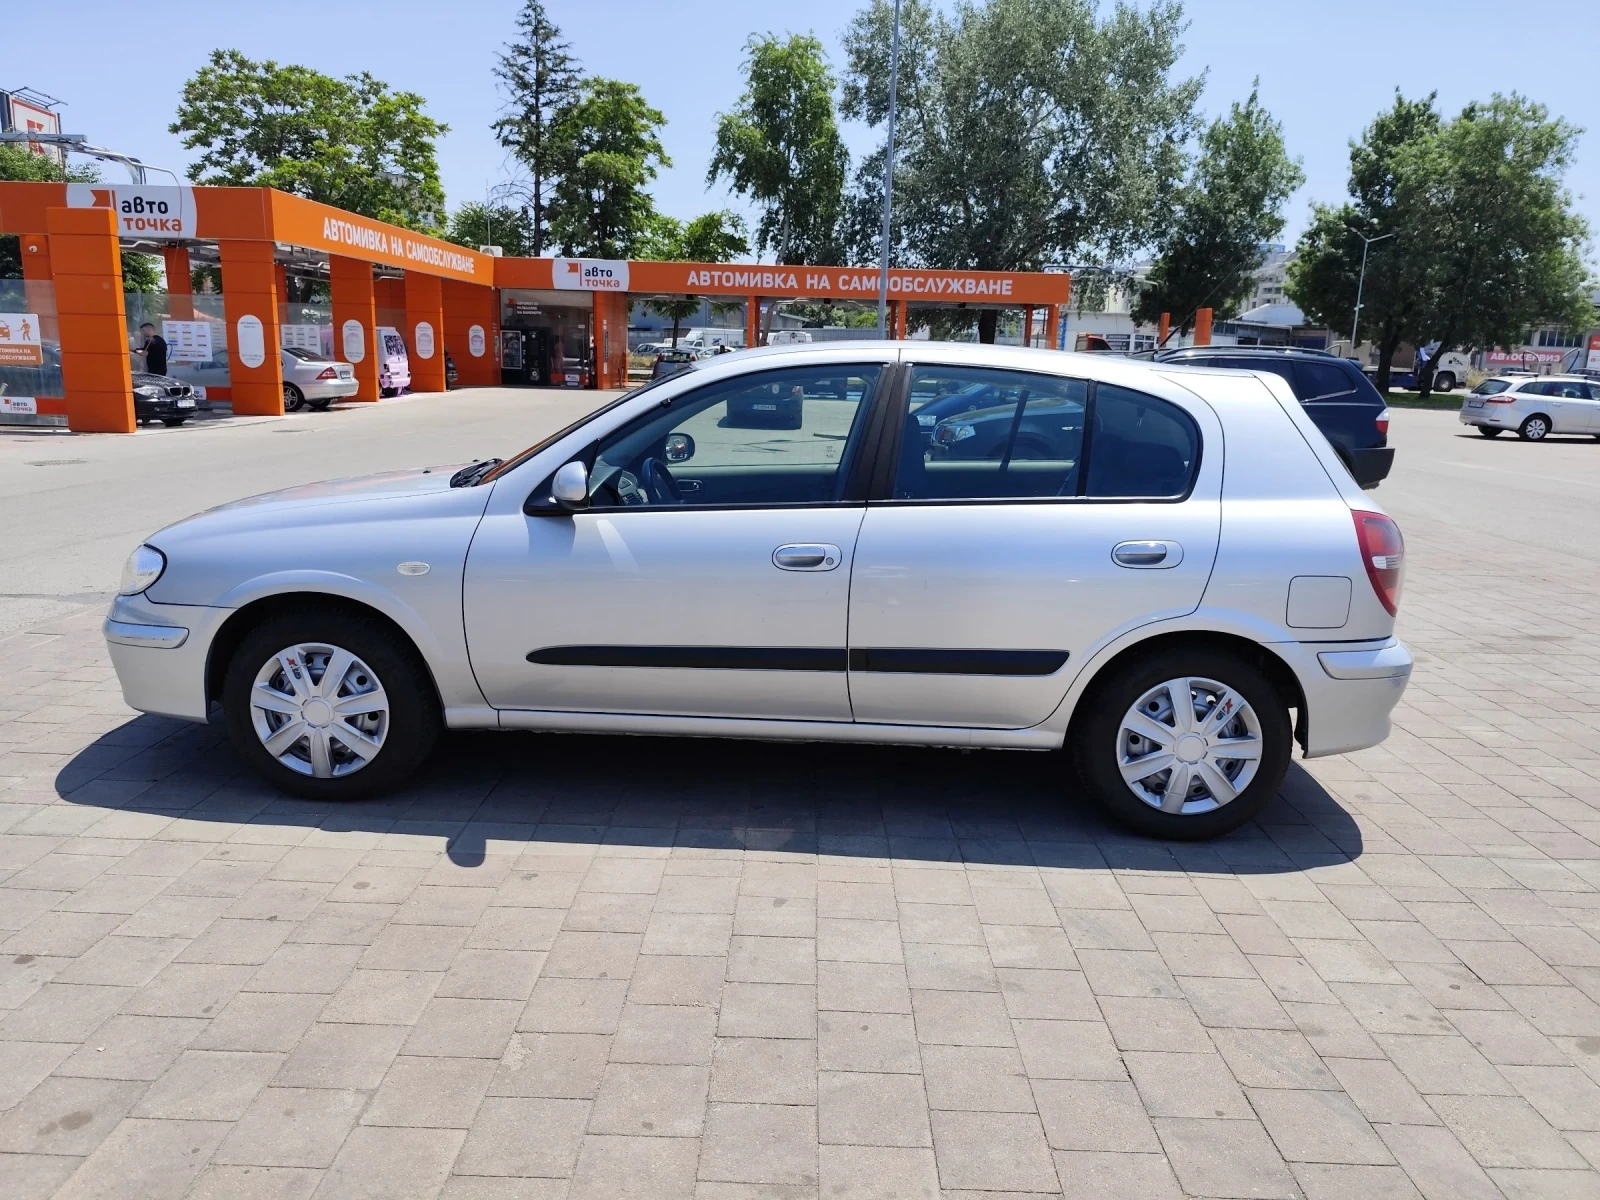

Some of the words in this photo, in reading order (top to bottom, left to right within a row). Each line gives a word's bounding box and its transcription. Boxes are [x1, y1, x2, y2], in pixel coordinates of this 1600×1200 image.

[121, 196, 169, 214] авто
[123, 218, 182, 232] точка
[323, 217, 388, 254] АВТОМИВКА
[390, 236, 404, 258] НА
[406, 240, 475, 274] САМООБСЛУЖВАНЕ
[584, 266, 613, 278] авто
[686, 270, 799, 289] АВТОМИВКА
[806, 274, 831, 290] НА
[585, 279, 620, 288] точка
